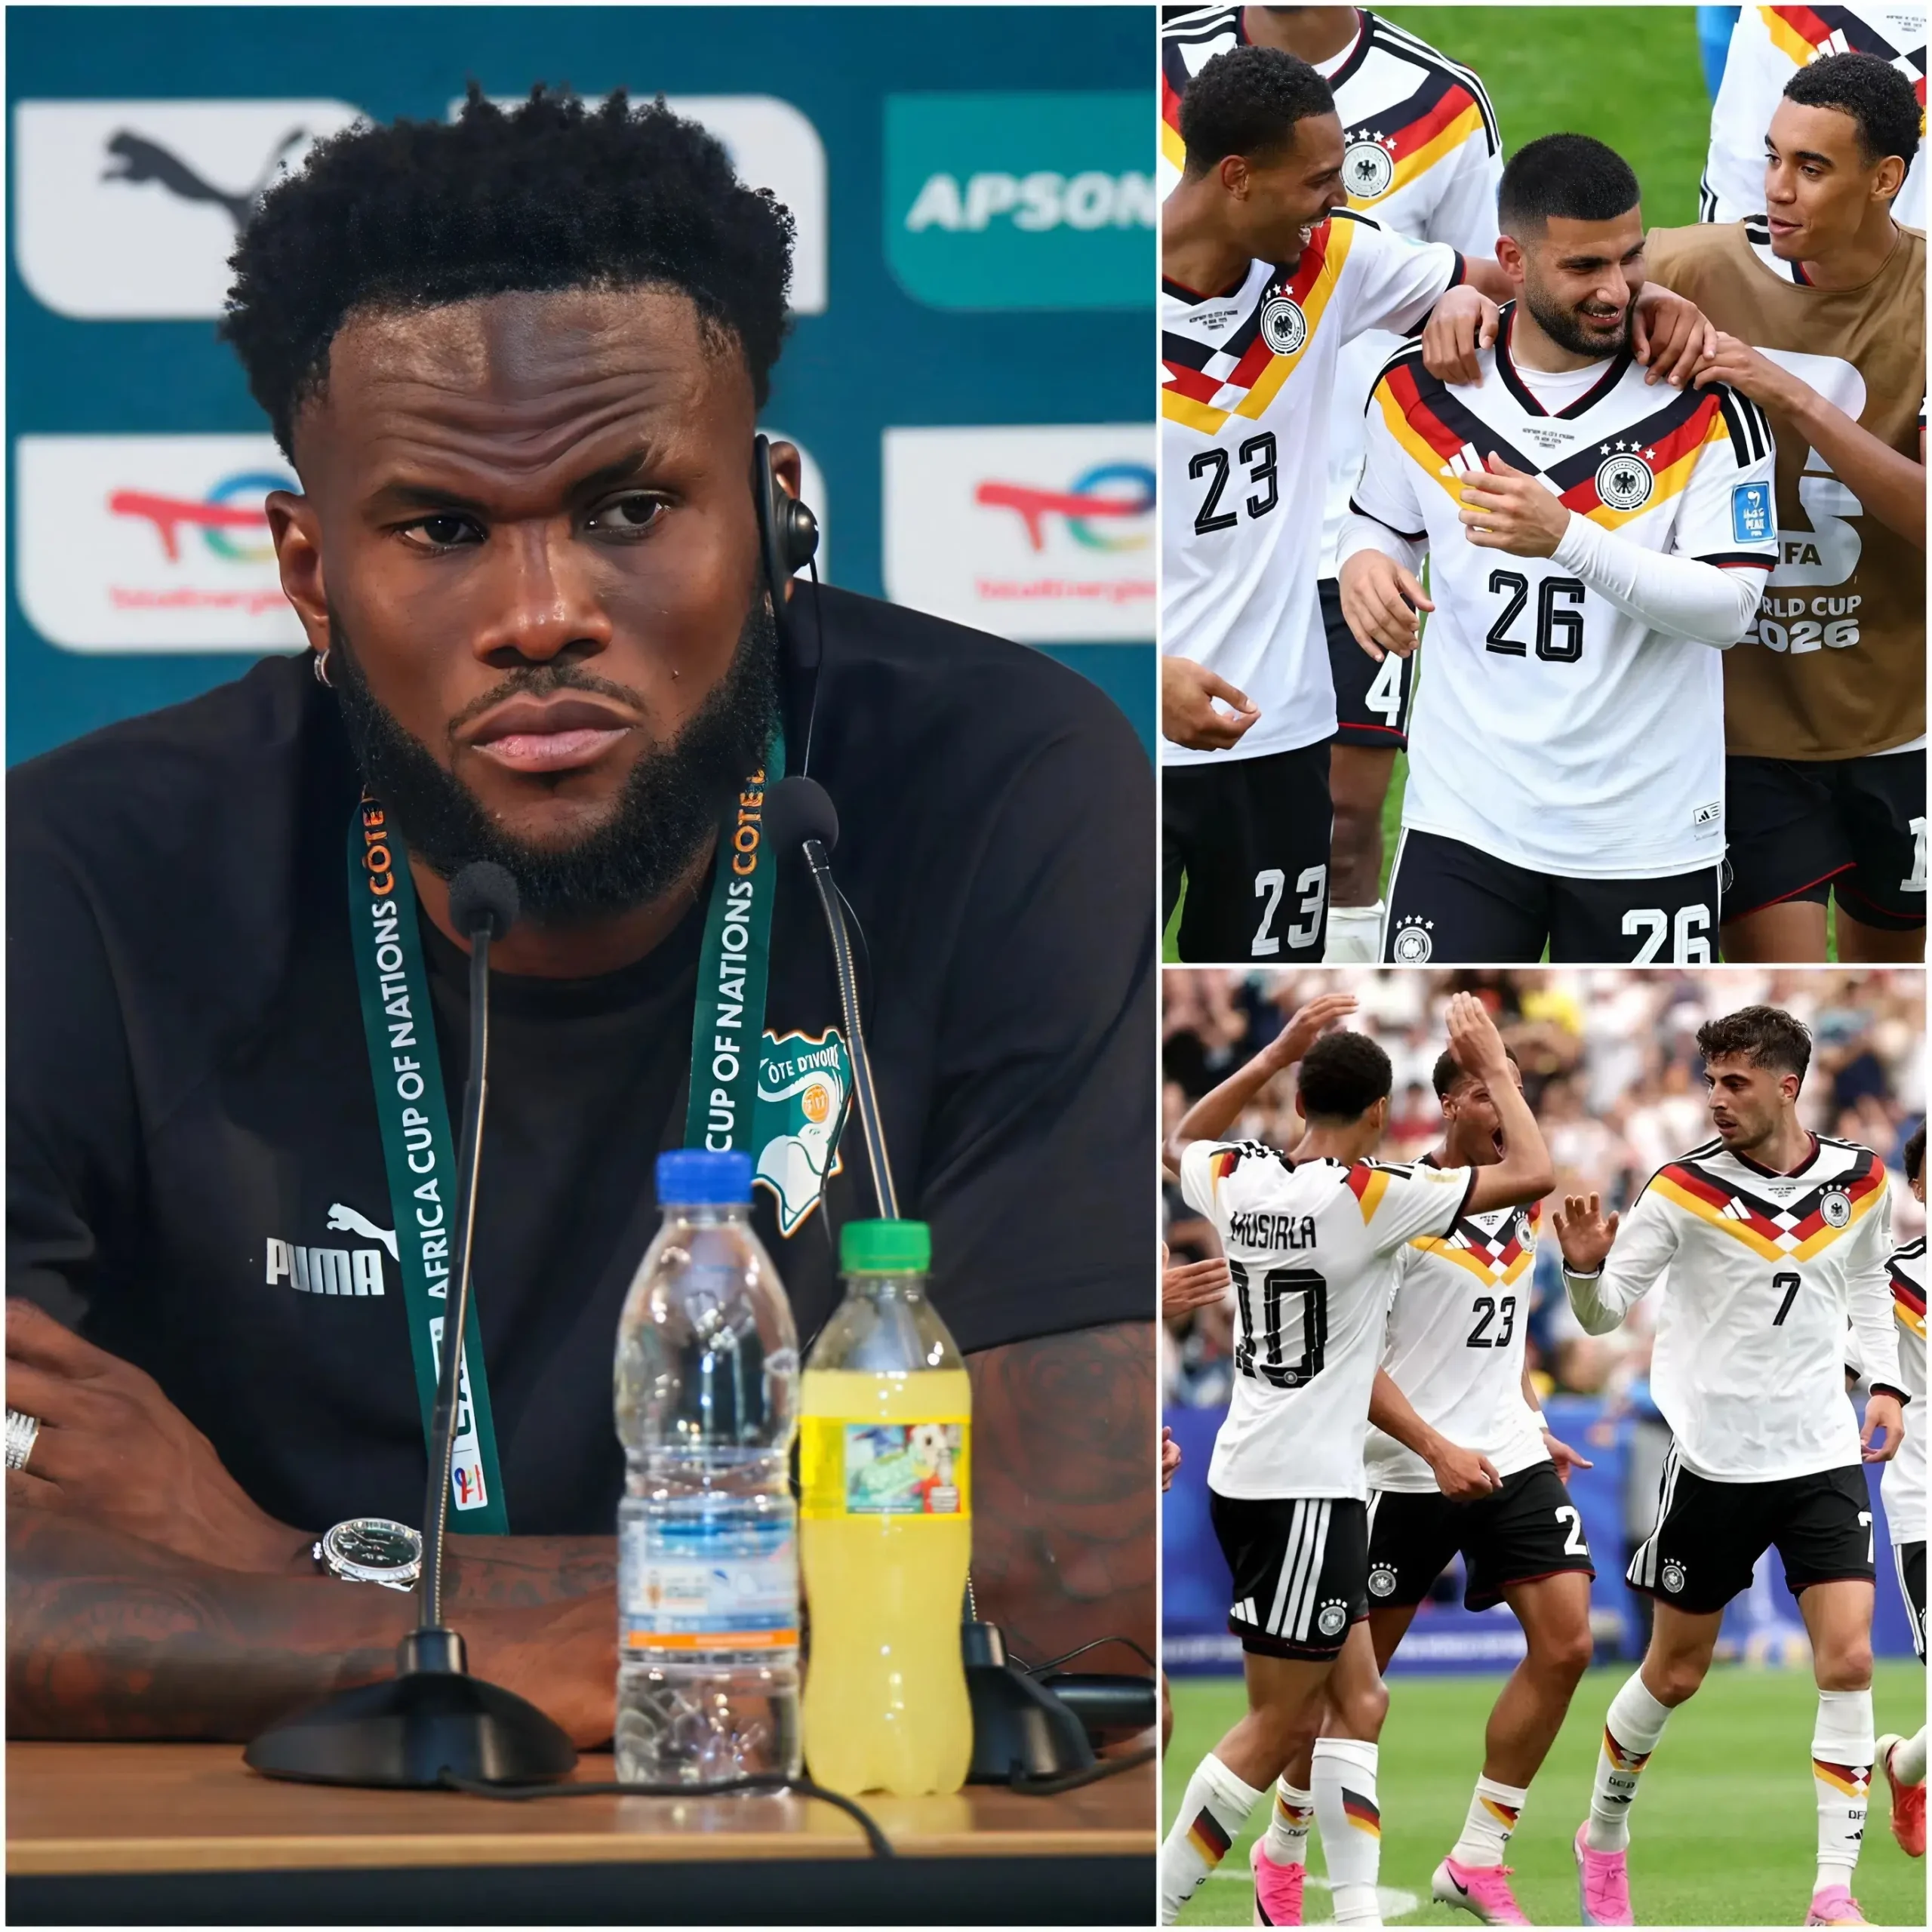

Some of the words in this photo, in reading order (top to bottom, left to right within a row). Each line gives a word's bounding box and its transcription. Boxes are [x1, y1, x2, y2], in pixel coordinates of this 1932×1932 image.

[1189, 432, 1279, 536] 23
[1774, 541, 1822, 565] FA
[1486, 569, 1585, 663] 26
[1761, 596, 1805, 617] RLD
[1811, 595, 1862, 617] CUP
[1364, 651, 1402, 726] 4
[1251, 864, 1326, 955] 23
[1621, 903, 1711, 963] 26
[371, 900, 417, 1048] NATIONS
[715, 881, 753, 1029] NATIONS
[395, 1056, 425, 1101] OF
[712, 1035, 740, 1081] OF
[402, 1108, 435, 1174] CUP
[706, 1088, 735, 1152] CUP
[414, 1178, 450, 1299] AFRICA
[1229, 1211, 1317, 1250] MUSIALA
[266, 1237, 385, 1296] PUMA
[1229, 1259, 1328, 1389] 10
[1466, 1296, 1516, 1348] 23
[1772, 1272, 1801, 1326] 7
